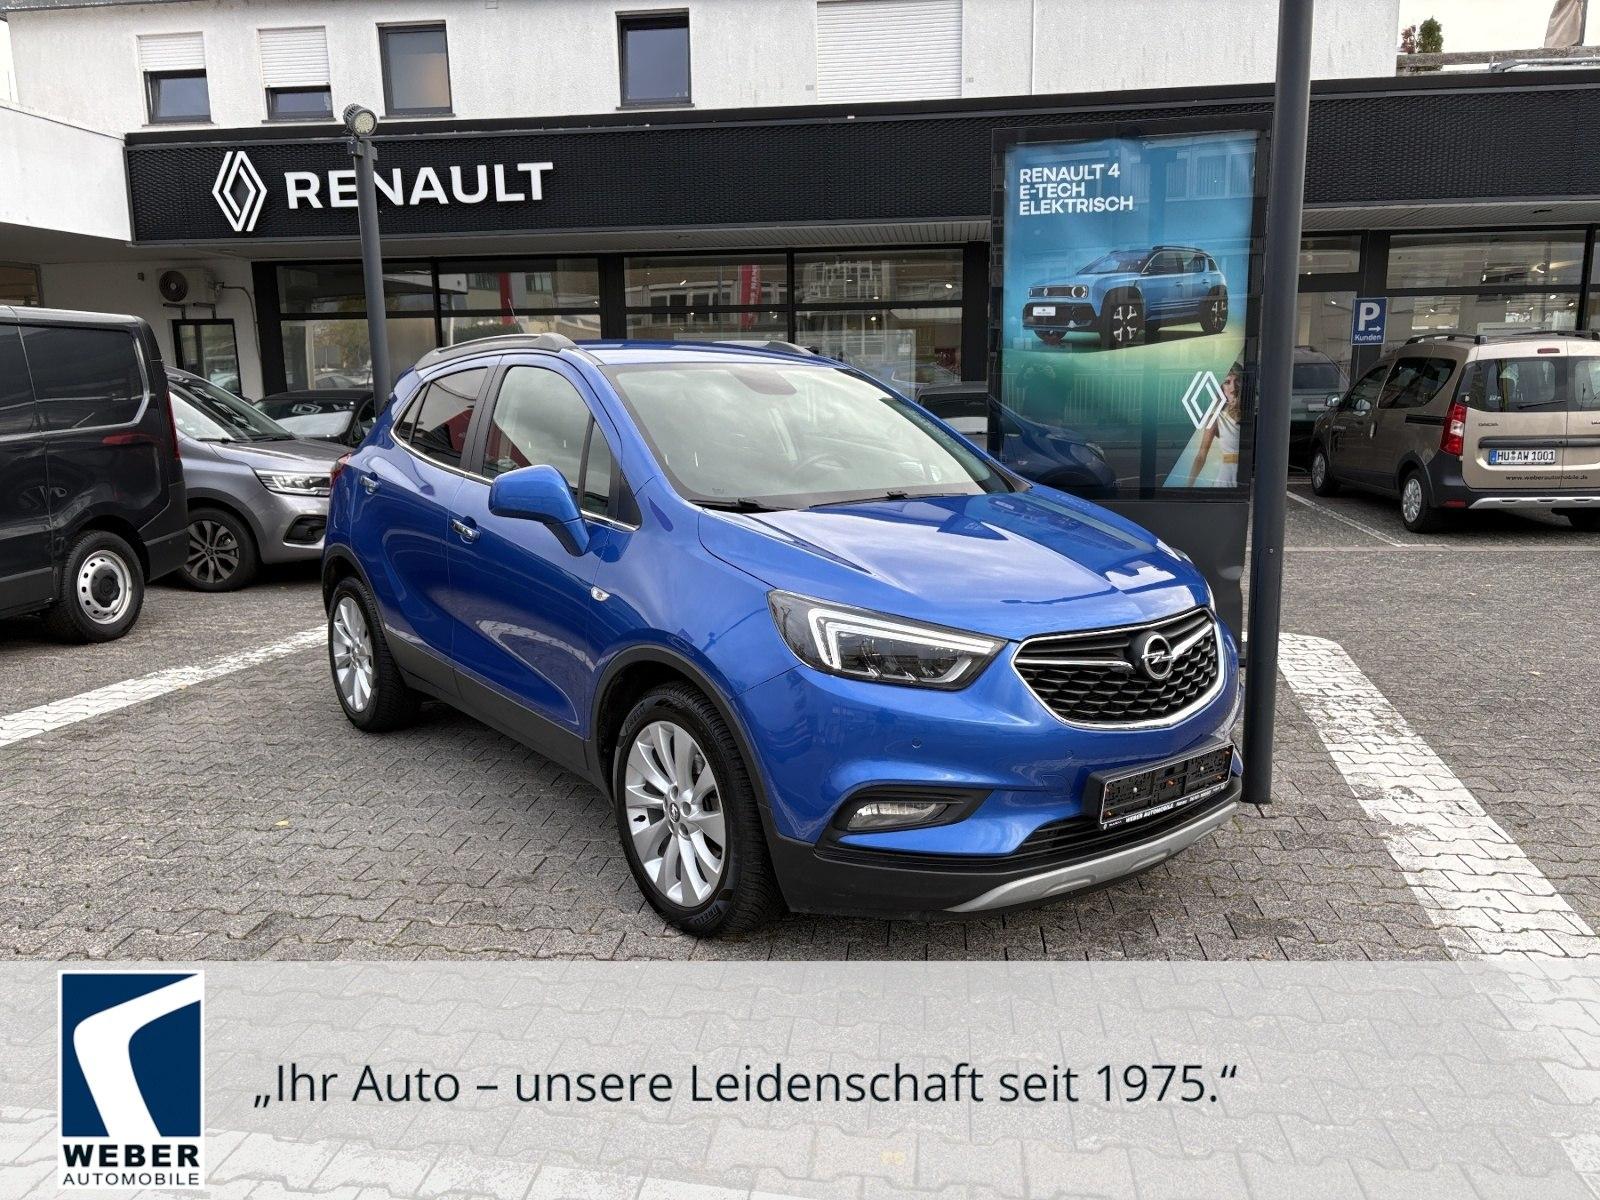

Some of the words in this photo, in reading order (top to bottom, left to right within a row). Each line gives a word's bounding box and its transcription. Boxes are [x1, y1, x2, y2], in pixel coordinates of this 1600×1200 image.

[1019, 164, 1104, 183] RENAULT
[1107, 163, 1120, 178] 4
[284, 162, 553, 209] RENAULT
[1019, 182, 1085, 200] E-TECH
[1019, 196, 1133, 216] ELEKTRISCH
[1358, 302, 1381, 331] P
[1354, 333, 1382, 341] Kunden
[1497, 451, 1510, 461] HU
[1517, 451, 1530, 461] AW
[1531, 451, 1554, 461] 1001
